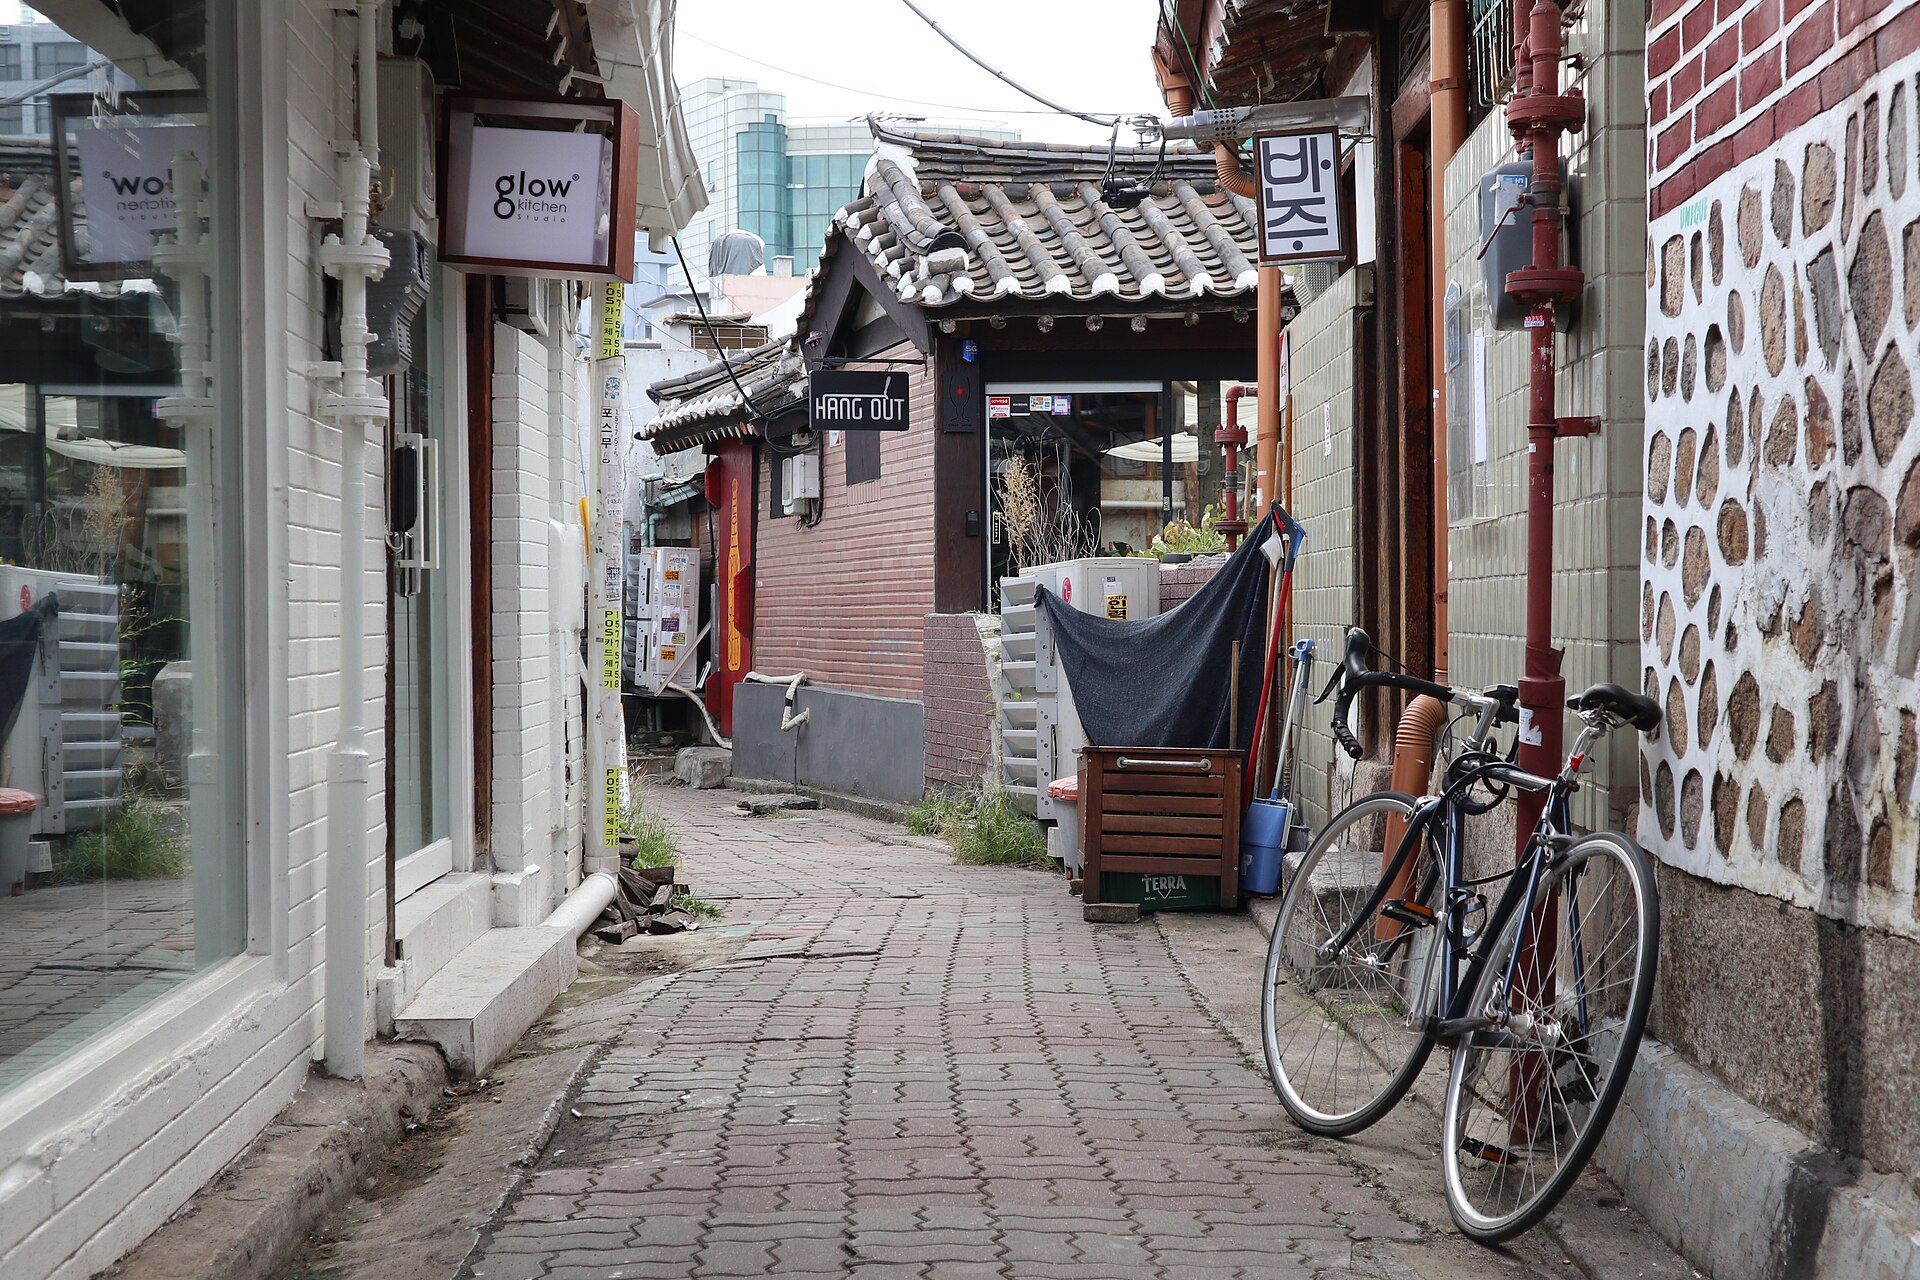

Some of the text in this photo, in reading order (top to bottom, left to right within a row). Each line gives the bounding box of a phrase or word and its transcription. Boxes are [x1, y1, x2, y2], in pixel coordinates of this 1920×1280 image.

[517, 198, 567, 213] kitchen
[517, 214, 566, 223] Studio
[815, 395, 905, 421] HANG OUT
[1141, 874, 1187, 893] TERRA
